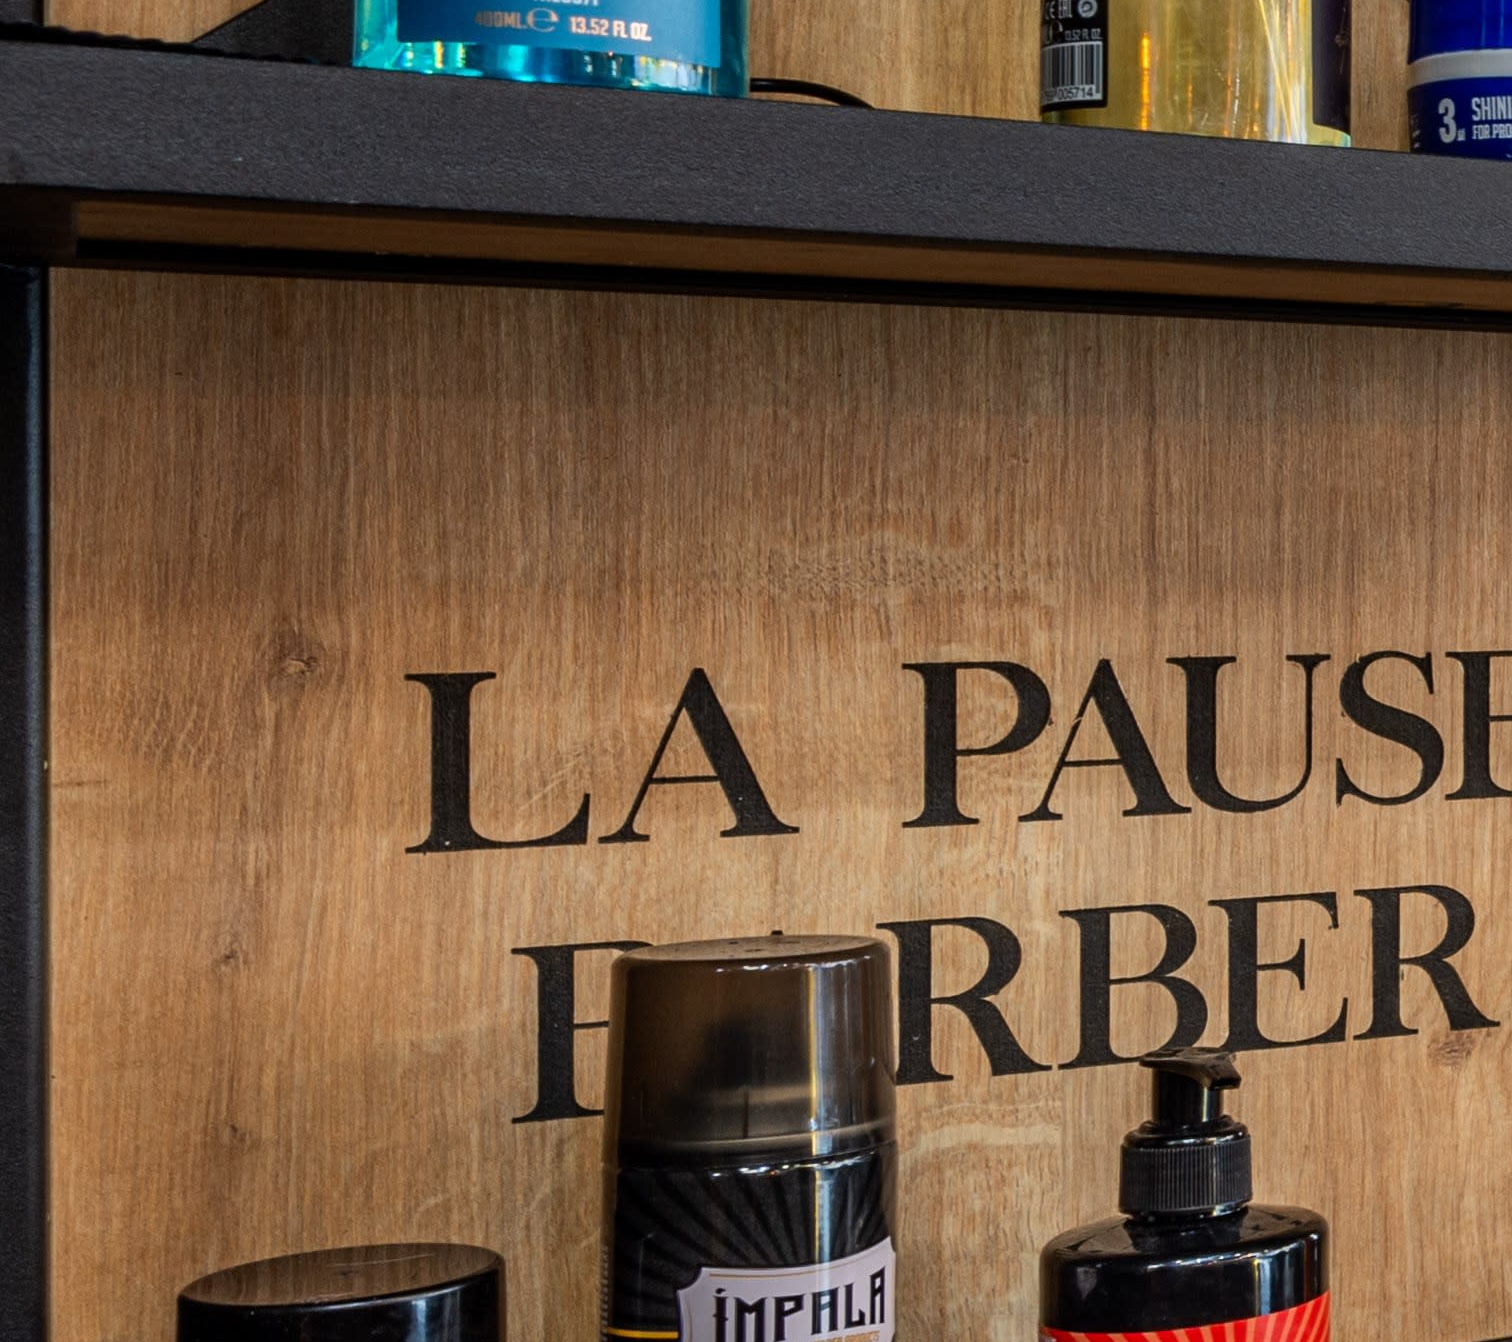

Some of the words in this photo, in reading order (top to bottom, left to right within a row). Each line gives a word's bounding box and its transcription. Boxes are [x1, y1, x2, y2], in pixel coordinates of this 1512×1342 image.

[570, 15, 609, 36] 13.52
[612, 19, 628, 39] FL
[1471, 124, 1490, 141] FOR
[403, 665, 801, 857] LA
